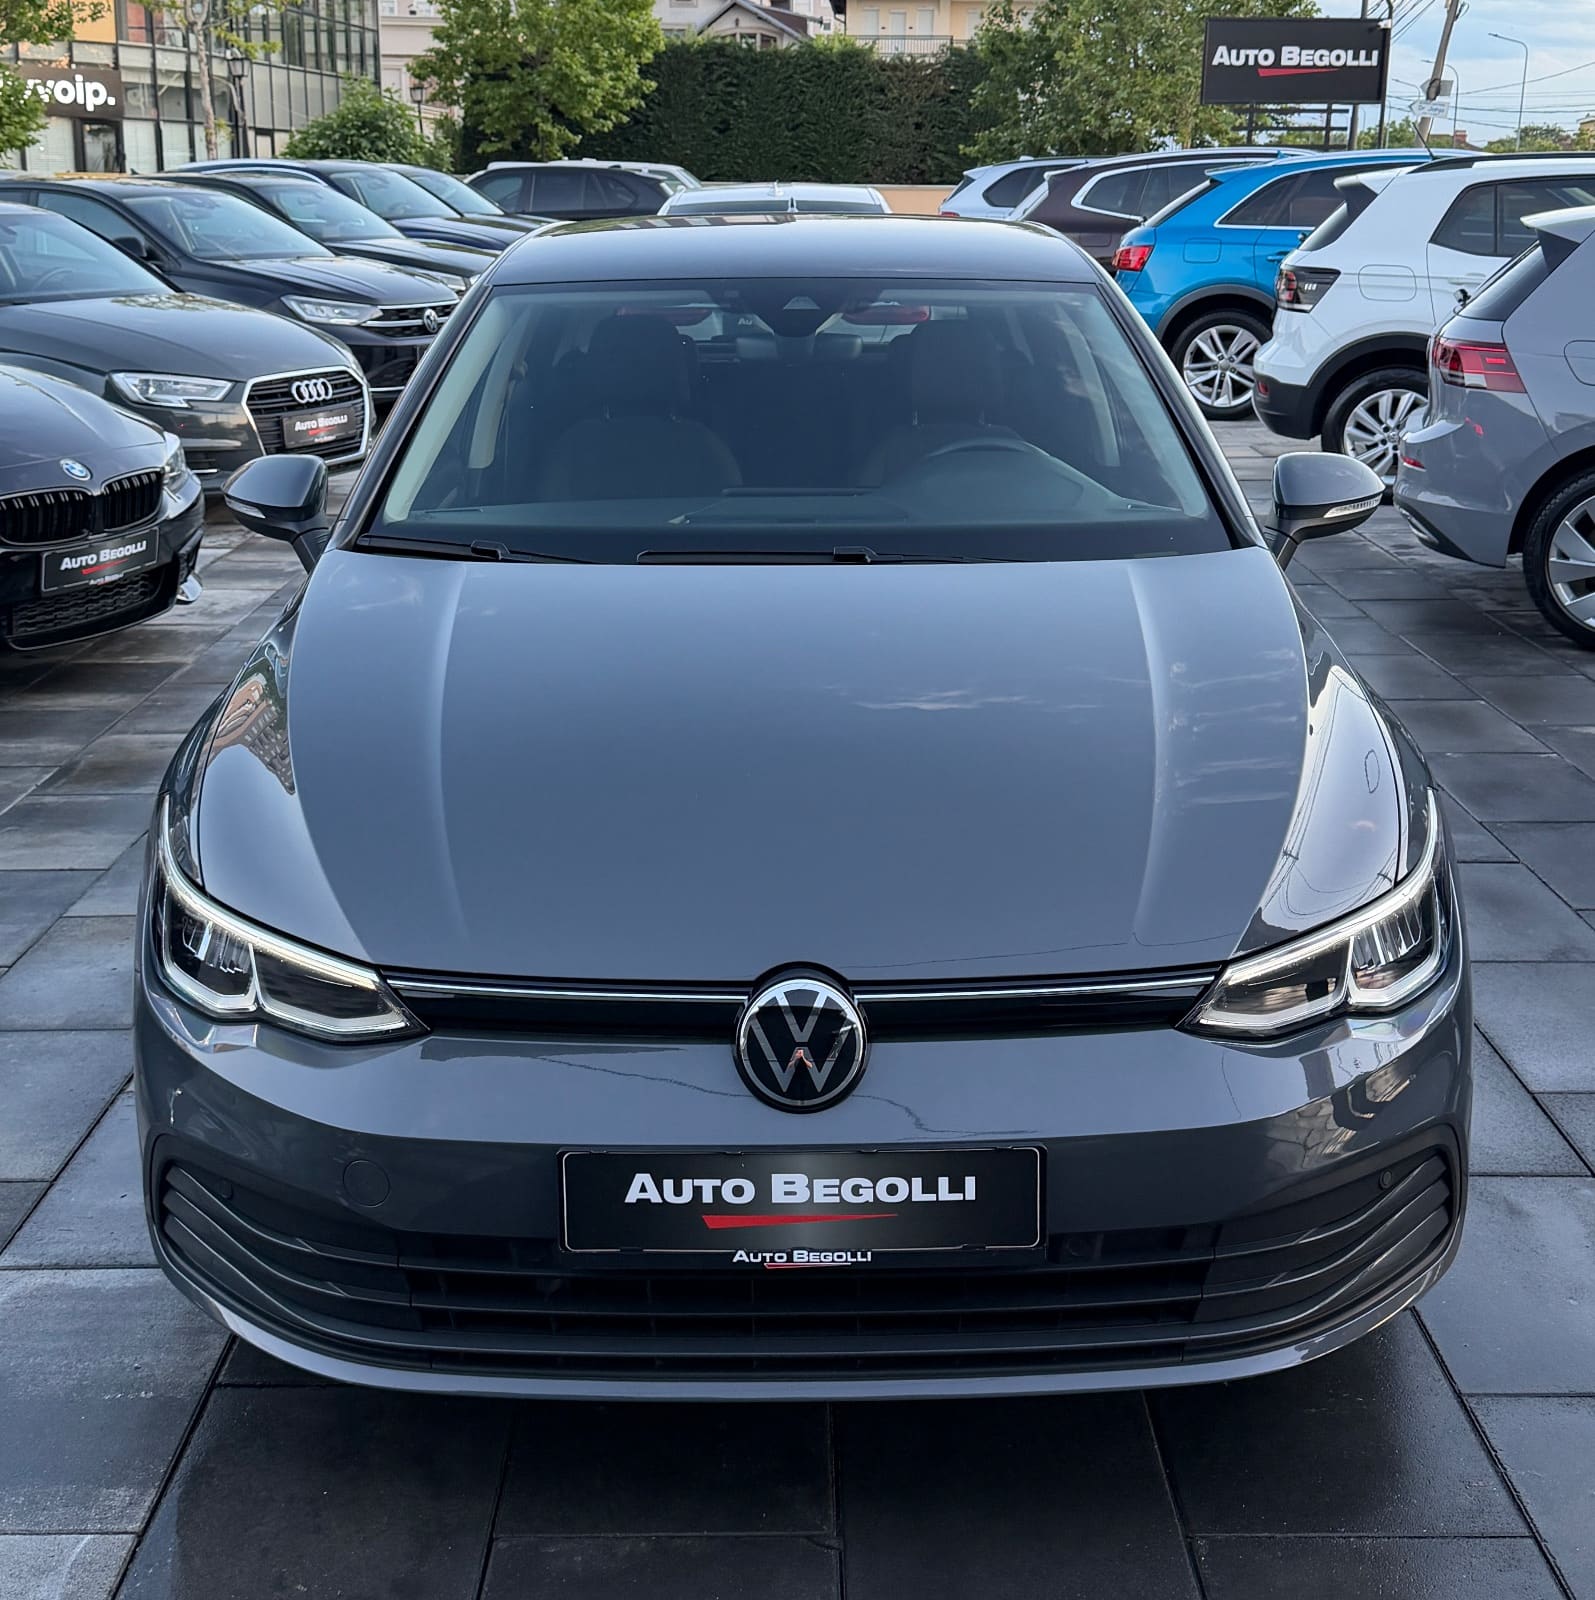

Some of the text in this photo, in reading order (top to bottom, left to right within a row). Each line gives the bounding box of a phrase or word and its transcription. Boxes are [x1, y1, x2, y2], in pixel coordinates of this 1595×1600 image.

[1211, 45, 1379, 67] AUTO BEGOLLI
[60, 540, 147, 571] AUTO BEGOLLI
[624, 1173, 976, 1204] AUTO BEGOLLI
[732, 1249, 872, 1263] AUTO BEGOLLI
